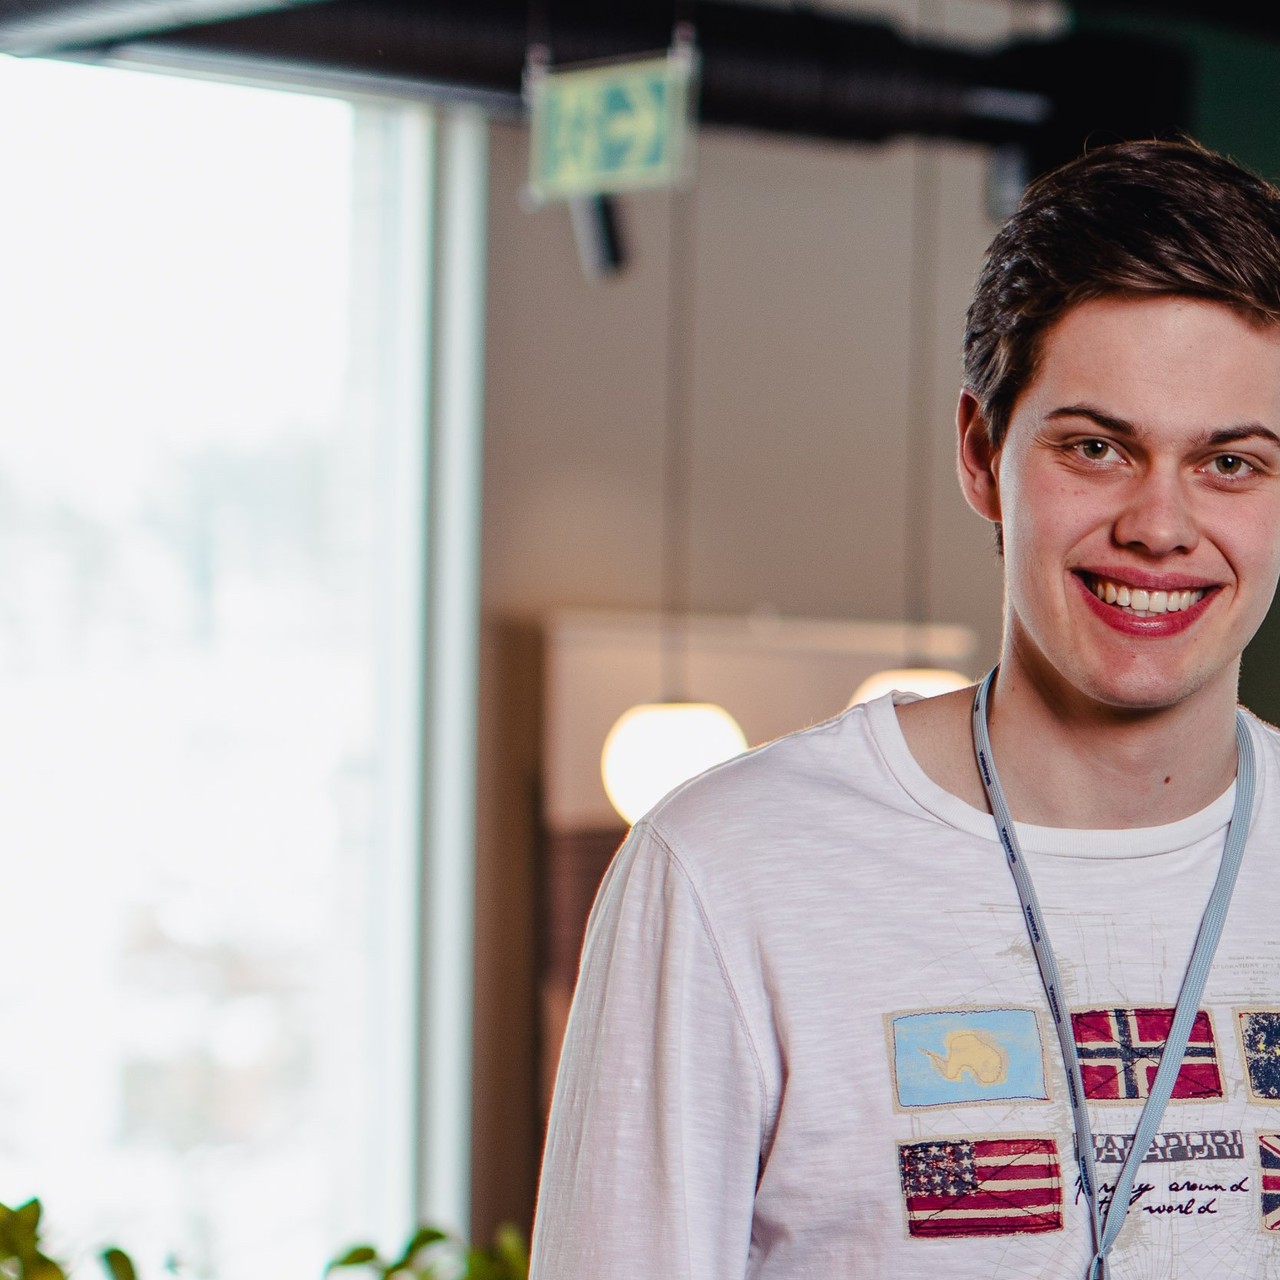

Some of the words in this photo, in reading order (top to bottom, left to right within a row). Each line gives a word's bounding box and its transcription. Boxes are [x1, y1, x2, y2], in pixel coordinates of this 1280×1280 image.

[1026, 904, 1040, 943] SKANSKA
[1168, 1176, 1250, 1193] around
[1142, 1197, 1218, 1216] world
